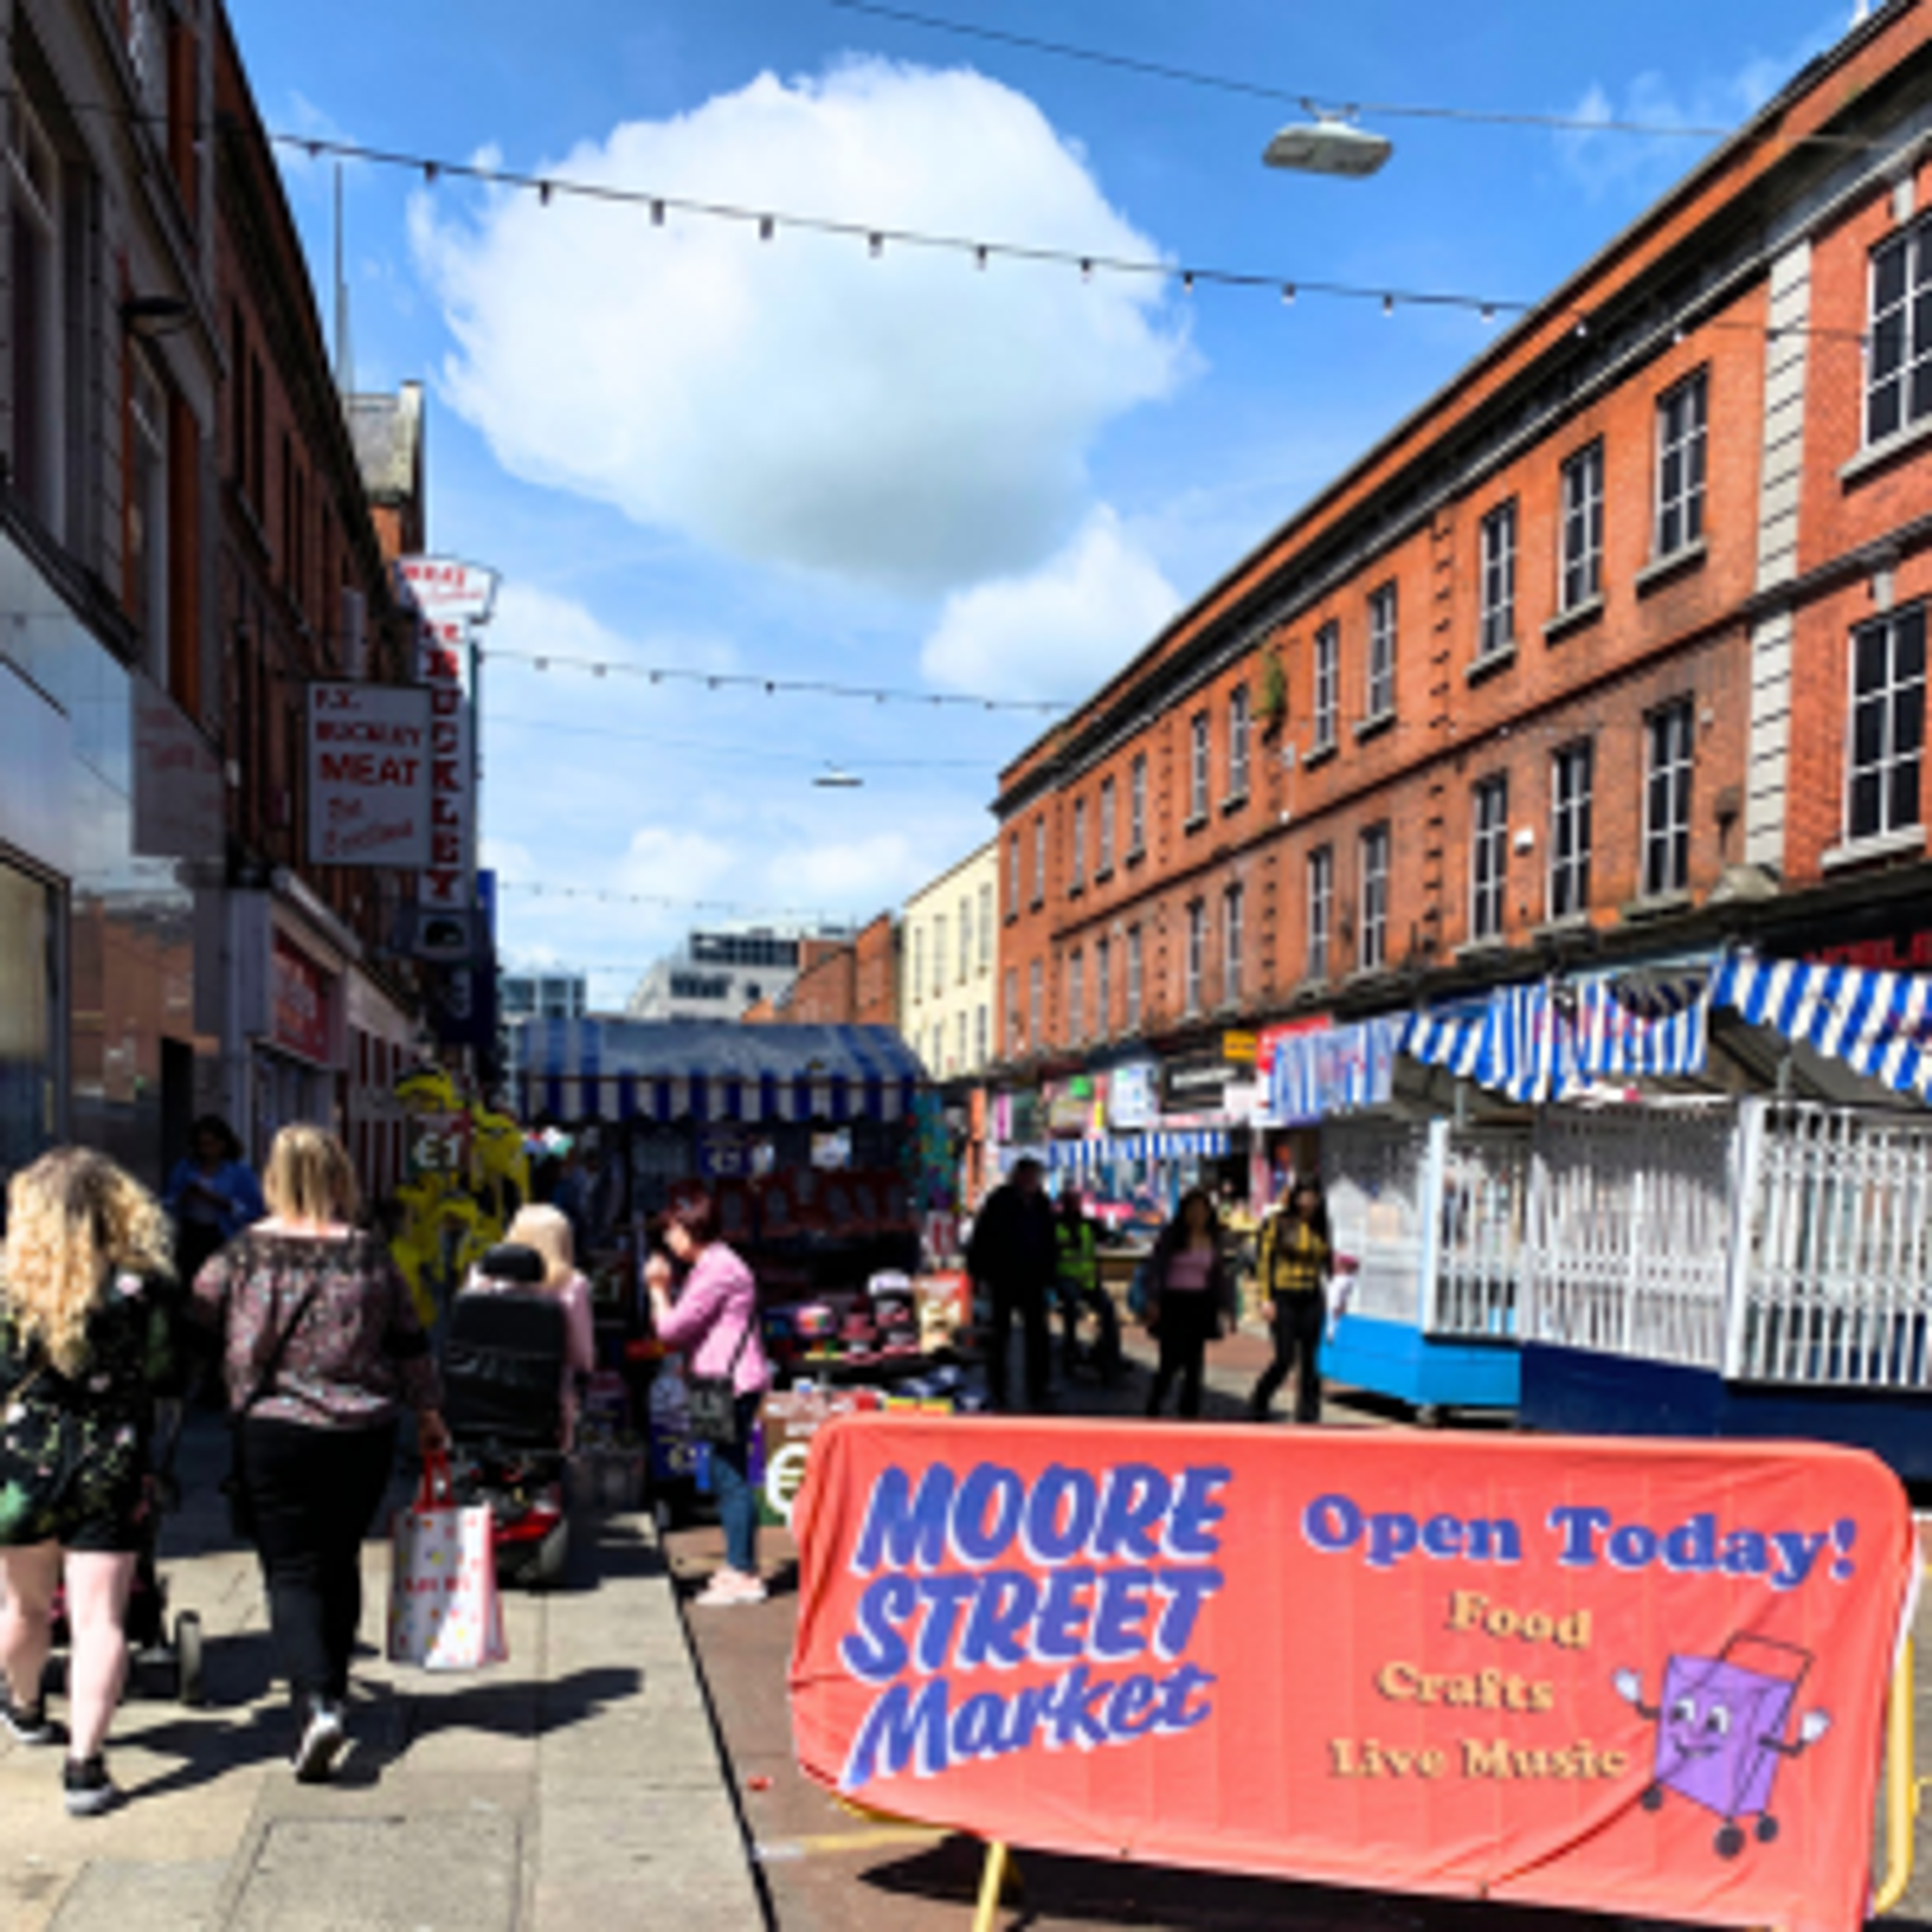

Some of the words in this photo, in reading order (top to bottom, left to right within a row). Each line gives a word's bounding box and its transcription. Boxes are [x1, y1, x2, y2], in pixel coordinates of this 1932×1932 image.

[318, 752, 420, 787] MEAT
[848, 1461, 1234, 1578] MOORE
[1301, 1493, 1522, 1569] Open
[1547, 1505, 1858, 1590] Today!
[837, 1566, 1225, 1682] STREET
[1444, 1590, 1592, 1649] Food
[1374, 1662, 1555, 1713] Crafts
[837, 1663, 1218, 1792] Market
[1328, 1737, 1445, 1779] Live
[1460, 1738, 1628, 1780] Music
